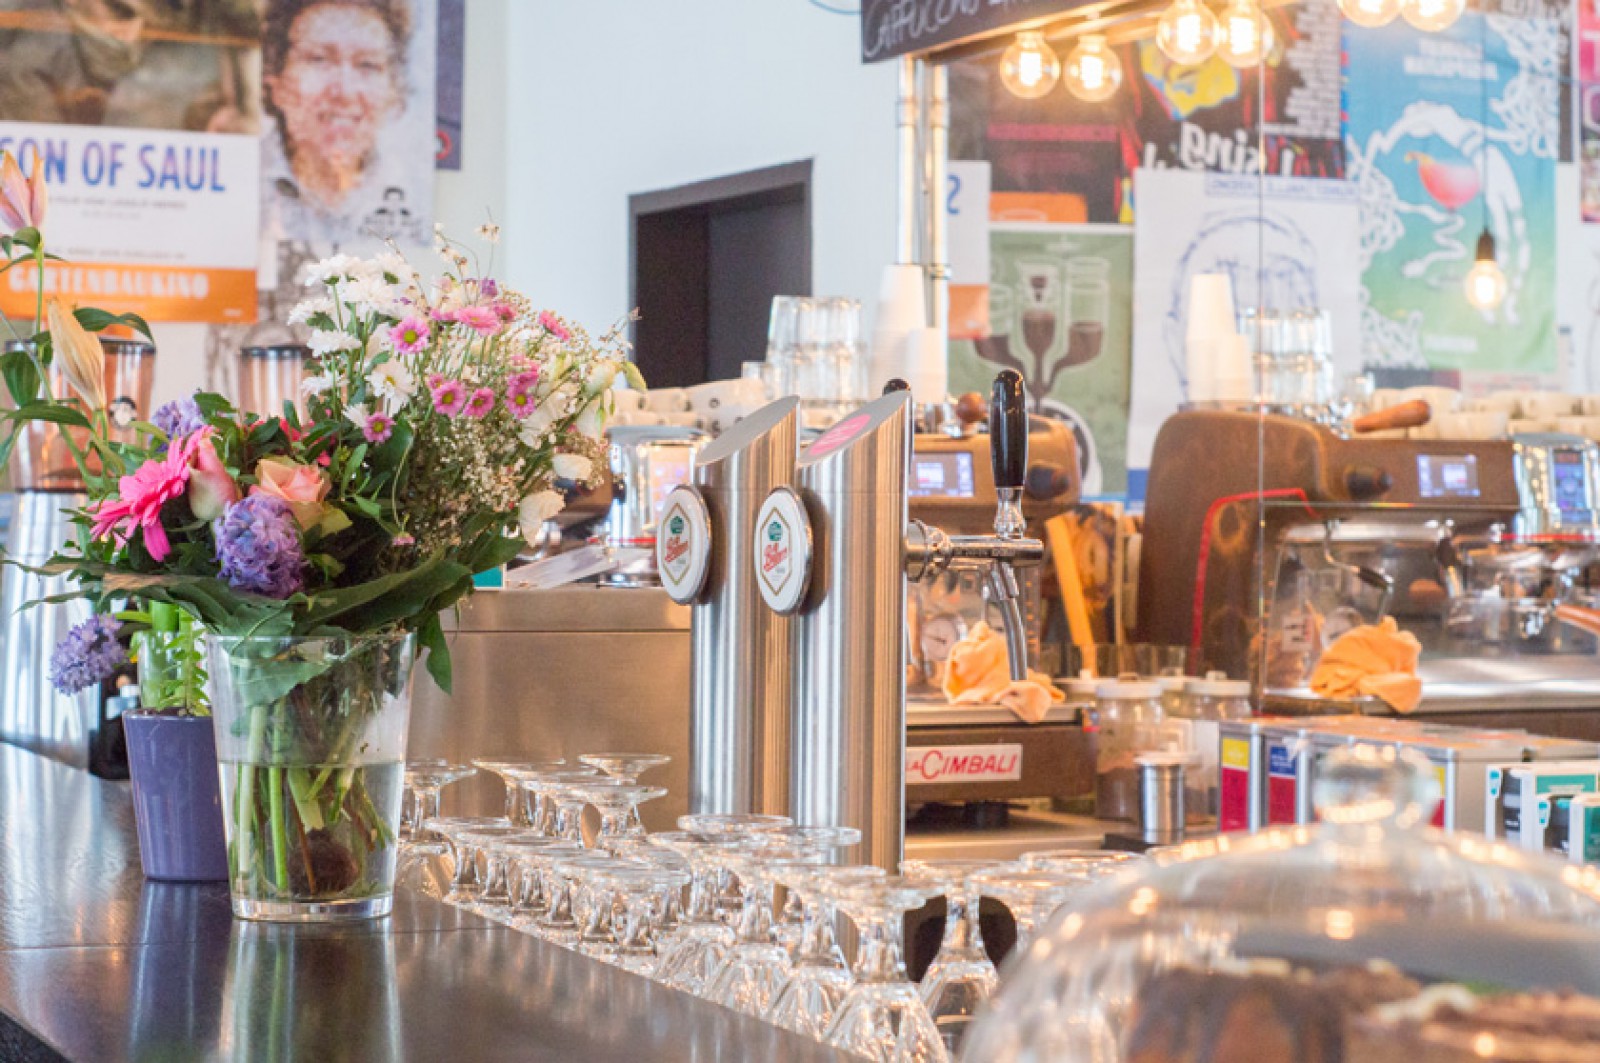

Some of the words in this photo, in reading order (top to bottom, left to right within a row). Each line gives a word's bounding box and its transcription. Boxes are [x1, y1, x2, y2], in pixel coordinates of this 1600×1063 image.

[82, 141, 126, 187] OF
[137, 145, 226, 192] SAUL
[921, 749, 1017, 779] CIMBALI
